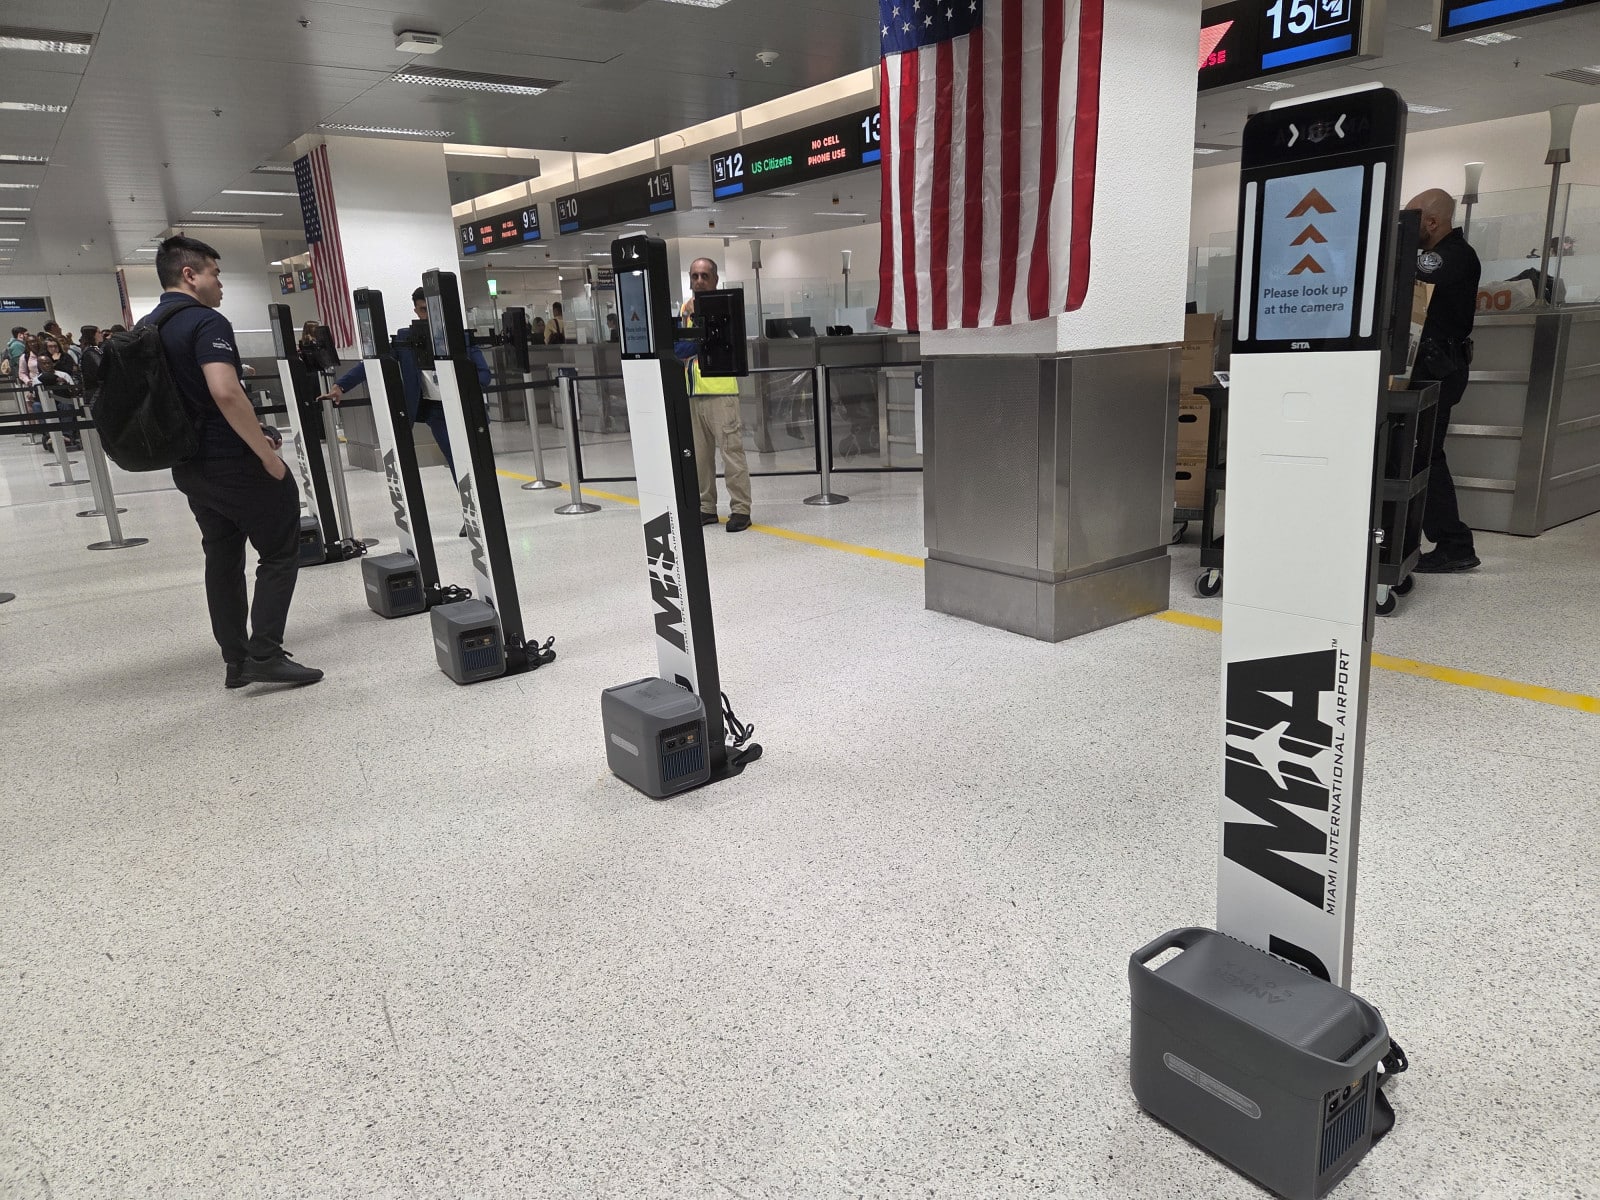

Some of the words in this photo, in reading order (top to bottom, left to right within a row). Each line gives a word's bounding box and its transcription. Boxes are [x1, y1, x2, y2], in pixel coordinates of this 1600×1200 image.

[1266, 0, 1314, 39] 15
[811, 139, 821, 150] NO
[823, 134, 840, 146] CELL
[725, 152, 744, 179] 12
[751, 161, 762, 174] US
[763, 155, 793, 171] Citizens
[807, 152, 830, 166] PHONE
[831, 148, 846, 160] USE
[647, 175, 660, 198] 11
[566, 198, 578, 218] 10
[522, 211, 529, 229] 9
[468, 226, 474, 242] 8
[1263, 287, 1300, 299] Please
[1302, 284, 1328, 297] look
[1332, 285, 1348, 297] up
[1264, 304, 1276, 315] at
[1279, 303, 1297, 314] the
[1301, 302, 1344, 313] camera
[1290, 341, 1311, 350] SITA
[643, 511, 687, 653] MIA
[1336, 649, 1350, 727] AIRPORT
[1223, 648, 1337, 911] MIA
[1329, 732, 1345, 864] INTERNATIONAL
[1326, 869, 1338, 915] MIAMI
